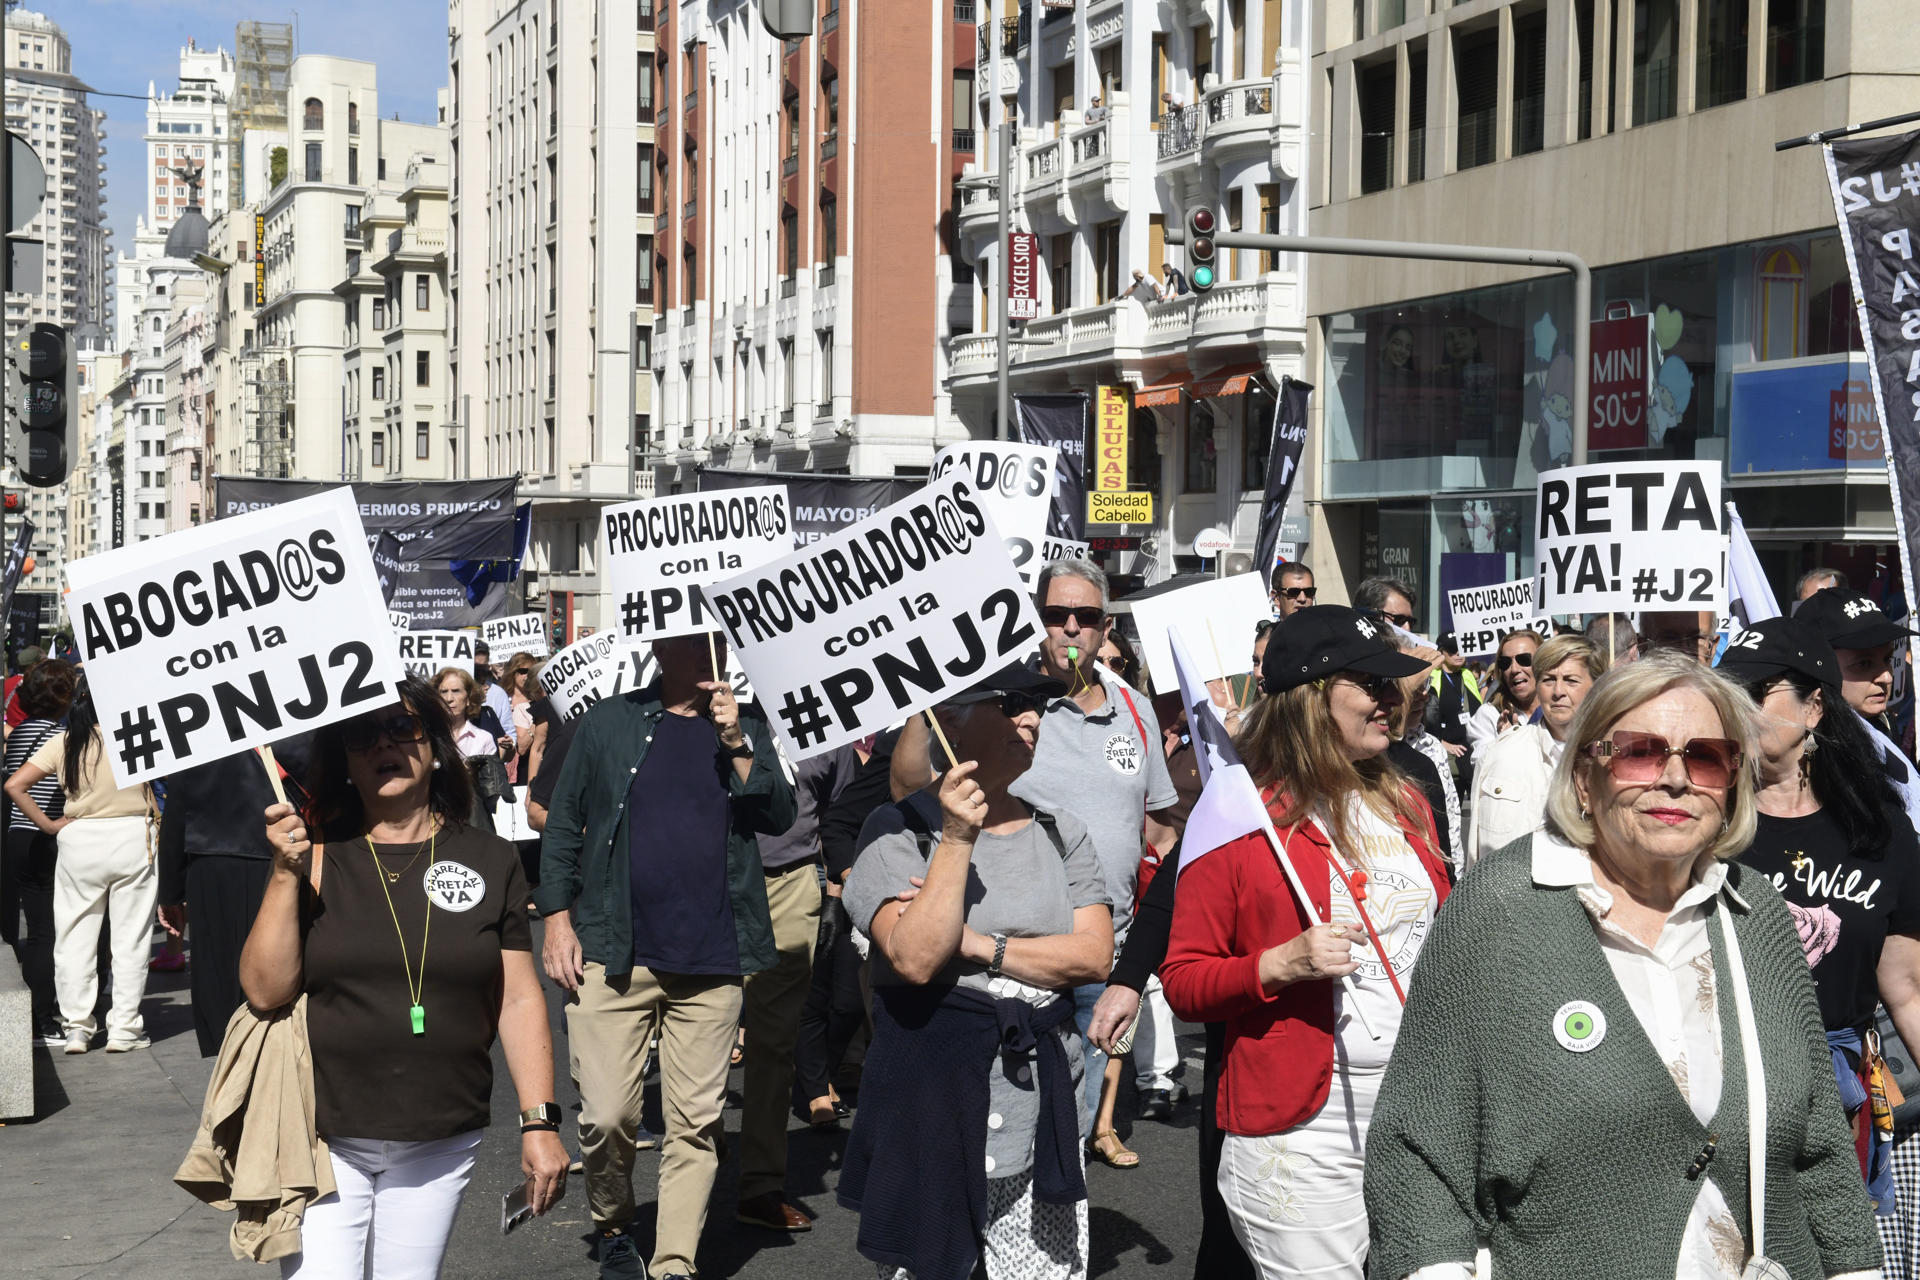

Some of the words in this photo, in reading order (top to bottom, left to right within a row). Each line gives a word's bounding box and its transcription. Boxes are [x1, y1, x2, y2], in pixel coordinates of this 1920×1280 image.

[256, 216, 264, 250] HOSTAL
[1013, 235, 1030, 298] EXCELSIOR
[1593, 347, 1641, 384] MINI
[1102, 388, 1124, 489] PELUCAS
[227, 501, 279, 514] PASI
[357, 502, 420, 516] ERMOS
[1092, 494, 1149, 507] Soledad
[1539, 472, 1717, 539] RETA
[114, 488, 122, 544] CATALONIA
[605, 493, 787, 556] PROCURADOR@S
[796, 504, 879, 522] MAYORÍ
[1094, 509, 1146, 522] Cabello
[1042, 541, 1084, 561] AD@S
[1199, 540, 1230, 549] vodafone
[1382, 547, 1409, 564] GRAN
[660, 558, 709, 577] con
[718, 551, 742, 570] la
[712, 480, 986, 649] PROCURADOR@S
[1538, 543, 1622, 609] ¡YA!
[1632, 568, 1714, 603] #J2
[82, 529, 346, 661] ABOGAD@S
[393, 588, 418, 597] sible
[420, 588, 461, 597] vencer,
[417, 600, 429, 608] se
[620, 582, 718, 637] #PN
[1481, 615, 1507, 626] con
[1511, 611, 1524, 621] la
[486, 617, 542, 642] #PNJ2
[823, 613, 895, 657] con
[898, 591, 940, 622] la
[165, 638, 239, 677] con
[247, 624, 287, 653] la
[399, 635, 473, 659] RETA
[518, 638, 545, 648] NORMATIVA
[1726, 630, 1765, 651] J2
[777, 587, 1037, 751] #PNJ2
[566, 678, 587, 698] con
[590, 668, 603, 681] la
[113, 640, 387, 776] #PNJ2
[1105, 735, 1131, 761] PASARELA
[1116, 757, 1136, 770] YA
[437, 880, 473, 890] RETA
[1374, 872, 1410, 890] CAN
[1794, 857, 1881, 910] Wild
[441, 890, 473, 904] YA
[1410, 919, 1426, 942] BE
[1560, 1003, 1583, 1016] TENGO
[1566, 1041, 1585, 1050] BAJA
